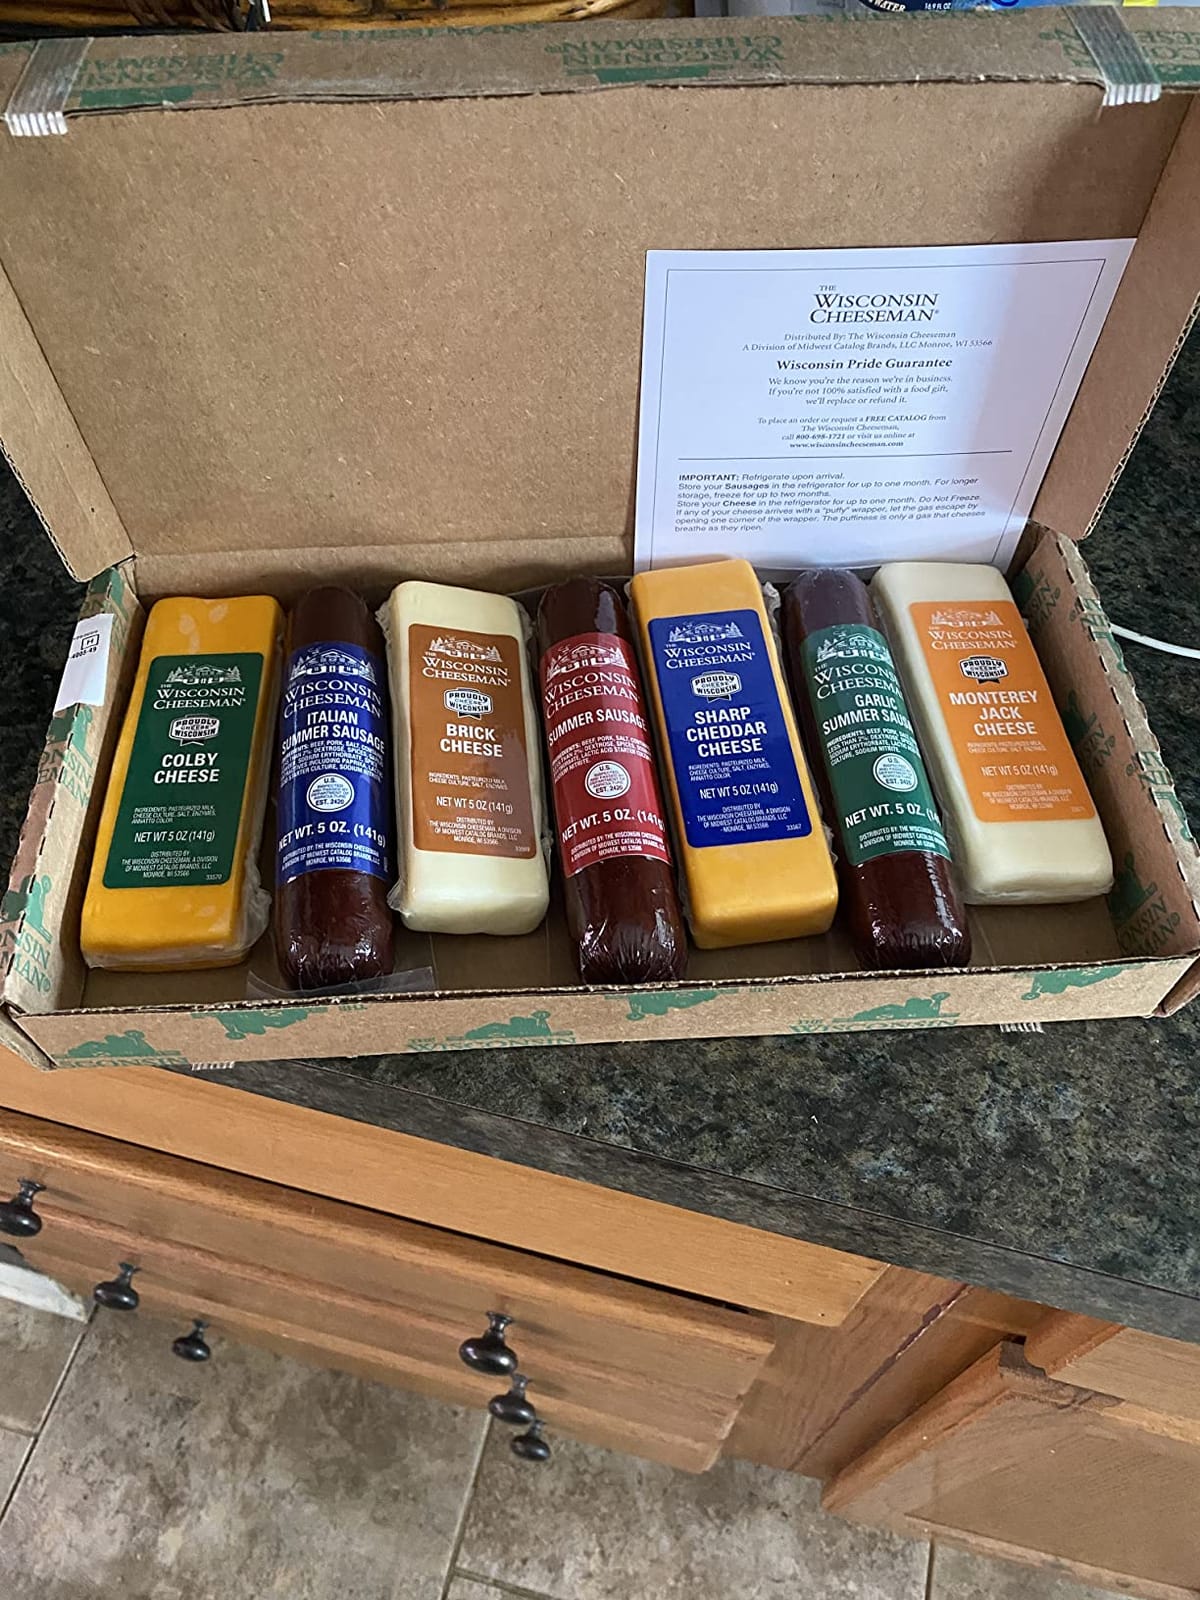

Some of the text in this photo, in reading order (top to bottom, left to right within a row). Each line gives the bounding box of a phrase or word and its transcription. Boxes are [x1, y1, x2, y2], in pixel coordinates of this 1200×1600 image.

[874, 0, 906, 12] WATER
[813, 294, 940, 308] WISCONSIN
[784, 332, 831, 341] Distributed
[832, 332, 847, 341] By:
[847, 332, 864, 340] The
[866, 331, 908, 339] Wisconsin
[742, 343, 749, 351] A
[750, 342, 785, 351] Division
[786, 342, 797, 350] of
[796, 342, 832, 350] Midwest
[833, 341, 865, 351] Catalog
[866, 341, 897, 350] Brands,
[898, 340, 918, 348] LLC
[917, 340, 955, 349] Monroe,
[777, 358, 953, 369] Wisconsin Pride Guarantee
[769, 377, 783, 385] We
[782, 377, 808, 385] know
[836, 376, 851, 384] the
[904, 375, 914, 383] in
[915, 375, 952, 383] business.
[769, 386, 777, 395] If
[804, 386, 820, 395] not
[821, 386, 846, 395] 100%
[846, 386, 881, 395] satisfied
[882, 385, 902, 394] with
[910, 385, 930, 394] food
[930, 385, 948, 395] gift,
[826, 396, 856, 406] replace
[867, 396, 897, 404] refund
[898, 396, 907, 404] it.
[678, 482, 702, 490] Store
[724, 481, 770, 490] Sausages
[796, 480, 845, 489] refrigerator
[933, 478, 951, 486] For
[950, 478, 978, 486] longer
[741, 473, 790, 481] Refrigerate
[928, 630, 1013, 641] WISCONSIN
[664, 642, 752, 658] WISCONSIN
[422, 655, 509, 676] WISCONSIN
[963, 659, 1002, 668] PROUDLY
[813, 663, 900, 687] WISCONS
[966, 668, 1005, 678] WISCONSIN
[545, 672, 638, 704] WISCONSIN
[695, 676, 735, 686] PROUDLY
[817, 677, 903, 700] CHEESEMA
[157, 687, 249, 699] WISCONSIN
[285, 679, 381, 706] WISCONSIN
[697, 683, 738, 695] WISCONSIN
[449, 692, 489, 703] PROUDLY
[854, 693, 898, 710] GARLIC
[949, 690, 1038, 705] MONTEREY
[283, 693, 381, 719] CHEESEMAN
[449, 701, 490, 712] WISCONSIN
[979, 706, 1022, 721] JACK
[175, 718, 217, 728] PROUDLY
[307, 709, 359, 726] ITALIAN
[694, 706, 752, 725] SHARP
[822, 708, 914, 735] SUMMER SAUSA
[174, 727, 216, 738] WISCONSIN
[446, 723, 497, 742] BRICK
[548, 708, 648, 747] SUMMER SAUSAGE
[686, 721, 767, 742] CHEDDAR
[974, 721, 1038, 736] CHEESE
[282, 724, 385, 755] SUMMER SAUSAGE
[439, 738, 504, 758] CHEESE
[697, 738, 764, 758] CHEESE
[161, 752, 219, 768] COLBY
[153, 768, 221, 785] CHEESE
[981, 764, 1059, 777] NET WT 5 OZ (141g)
[595, 786, 608, 794] EST.
[699, 781, 779, 799] NET WT 5 OZ (141g)
[436, 796, 514, 815] NET WT 5 OZ (141g)
[845, 808, 867, 829] NET
[868, 803, 894, 818] WT.
[895, 803, 904, 815] 5
[926, 808, 941, 826] (14
[562, 822, 581, 843] NET
[579, 814, 601, 831] WT.
[603, 811, 612, 823] 5
[614, 809, 635, 822] OZ.
[134, 829, 216, 843] NET WT 5 OZ (141g)
[294, 824, 315, 840] WT.
[317, 822, 326, 834] 5
[329, 821, 351, 834] OZ.
[354, 823, 387, 849] (141g)
